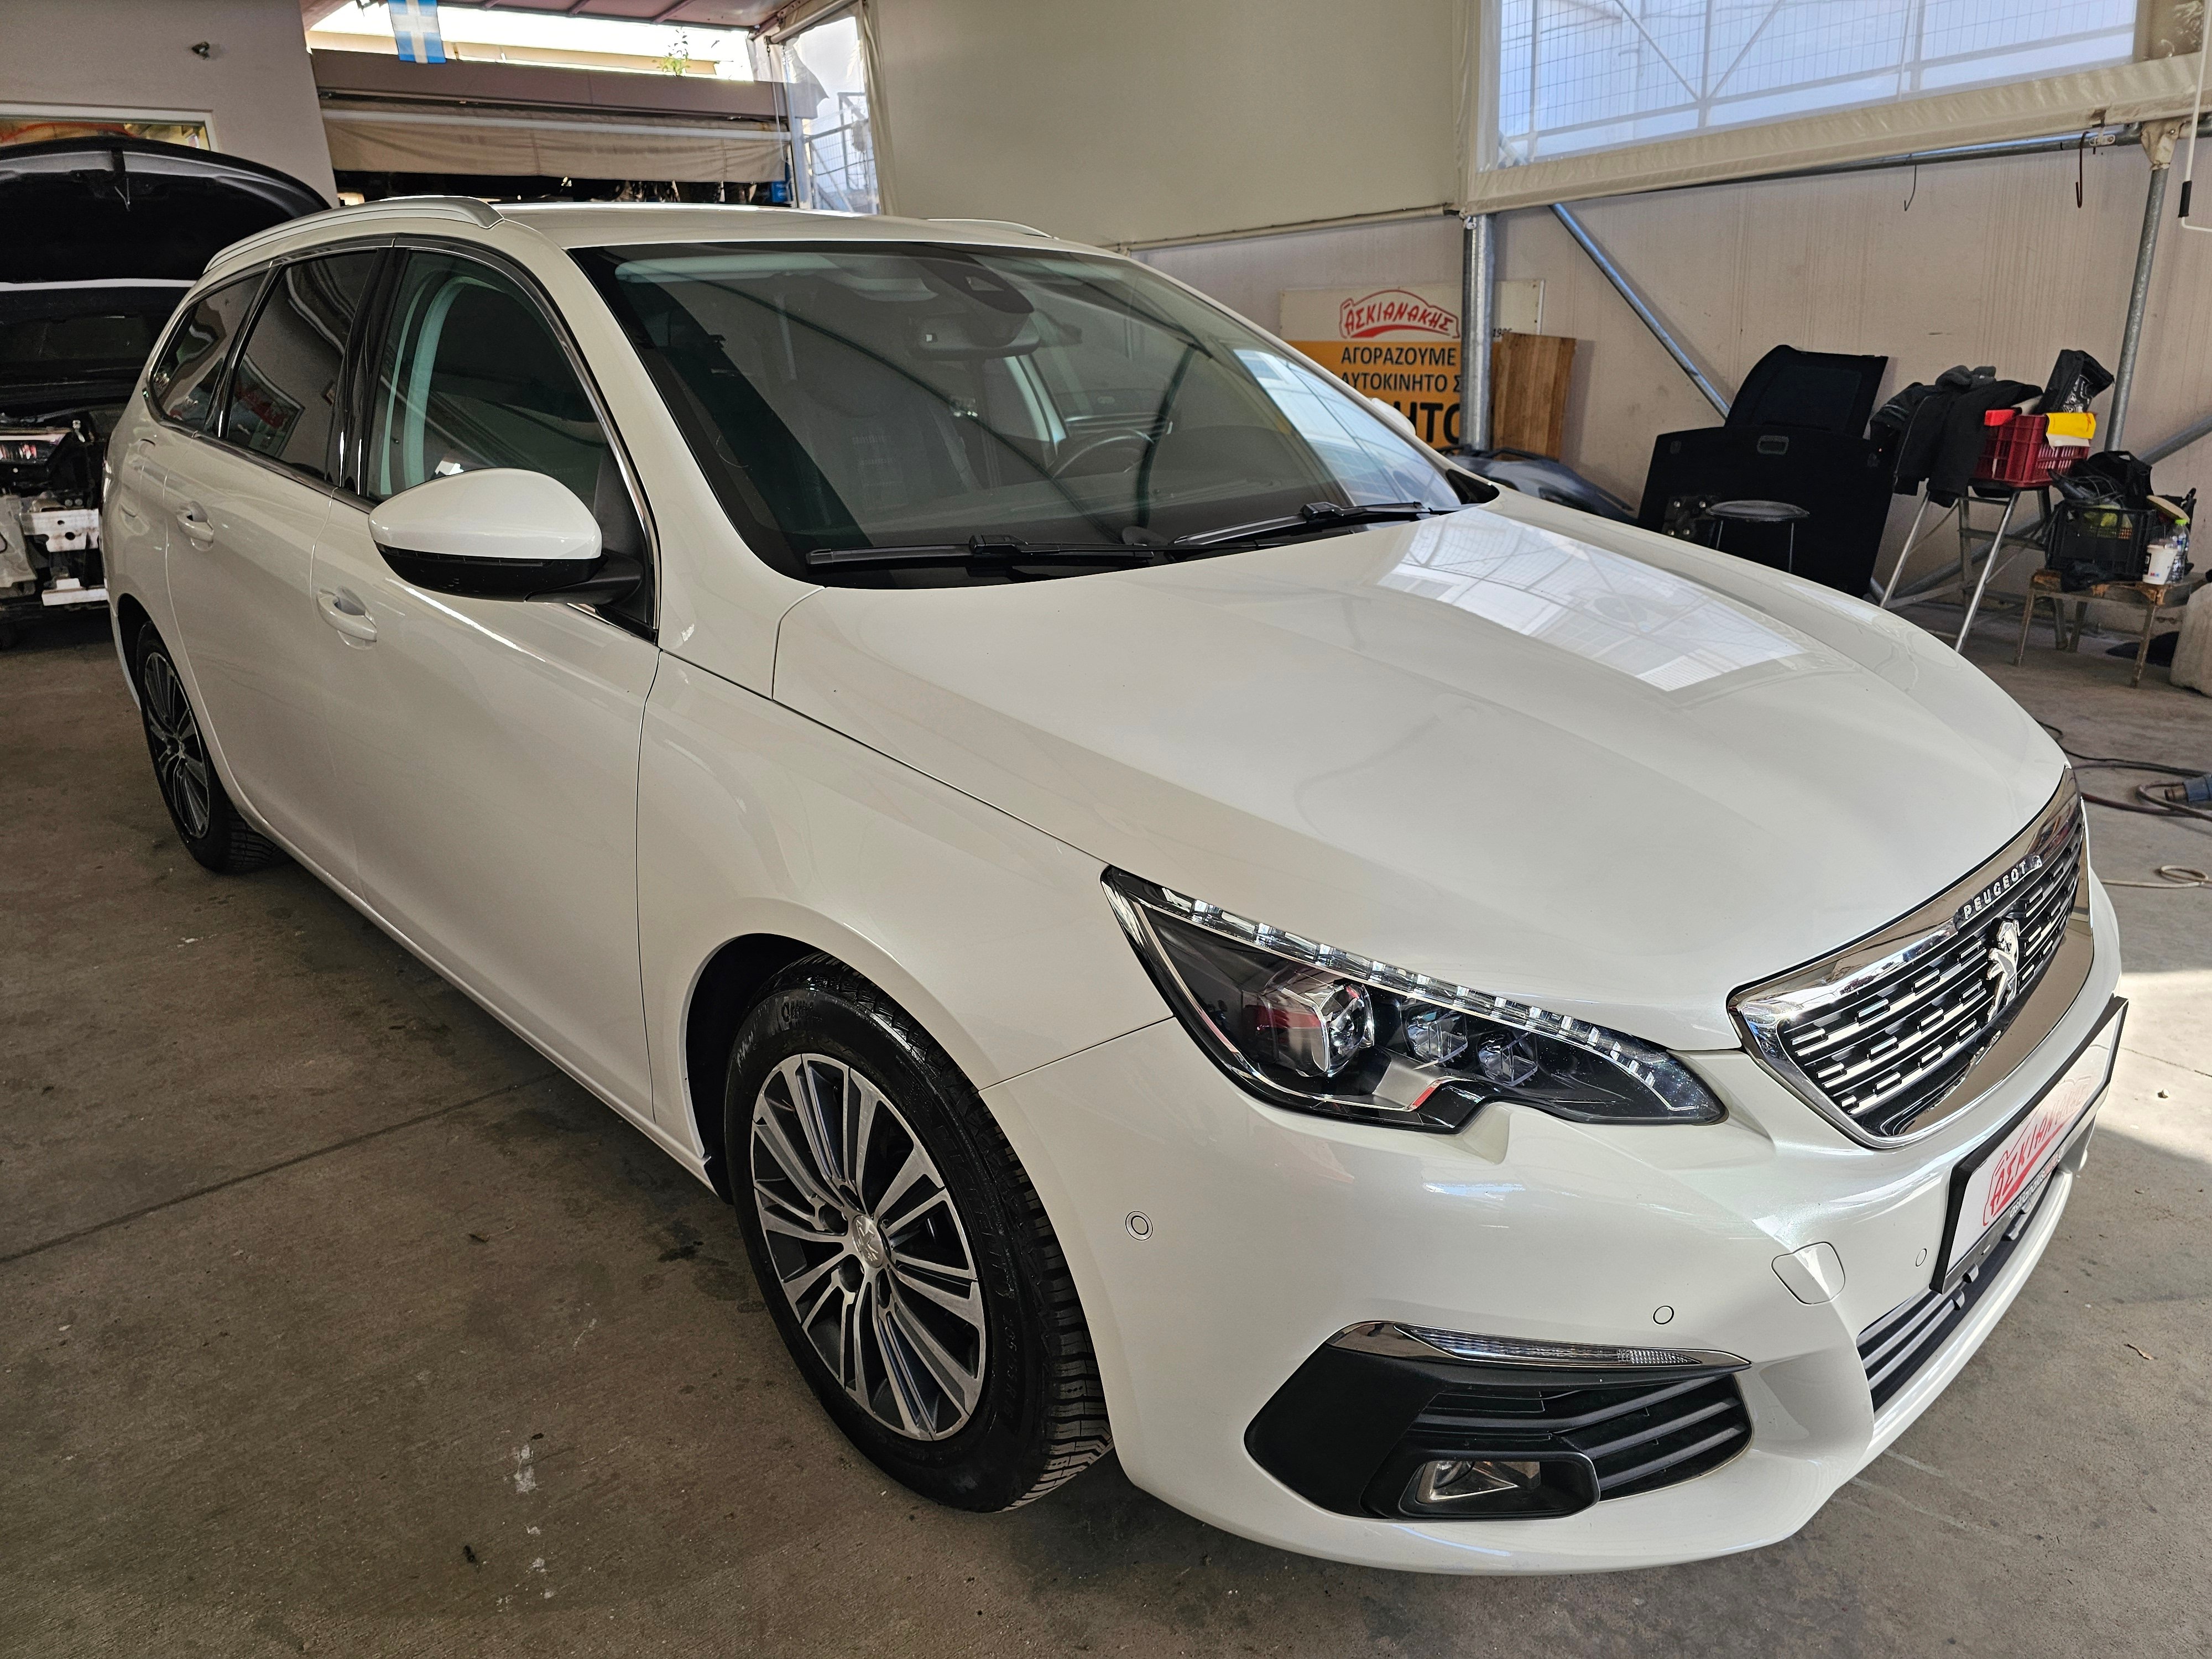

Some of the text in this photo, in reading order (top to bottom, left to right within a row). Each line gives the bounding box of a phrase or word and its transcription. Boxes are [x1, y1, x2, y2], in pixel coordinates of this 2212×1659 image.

[1344, 302, 1454, 335] ΑΣΚΙΑΝΑΚΗΣ
[1341, 347, 1456, 366] ΑΓΟΡΑΖΟΥΜΕ
[1342, 372, 1448, 393] ΑΥΤΟΚΙΝΗΤΟ
[1963, 860, 2026, 920] PEUGEOT
